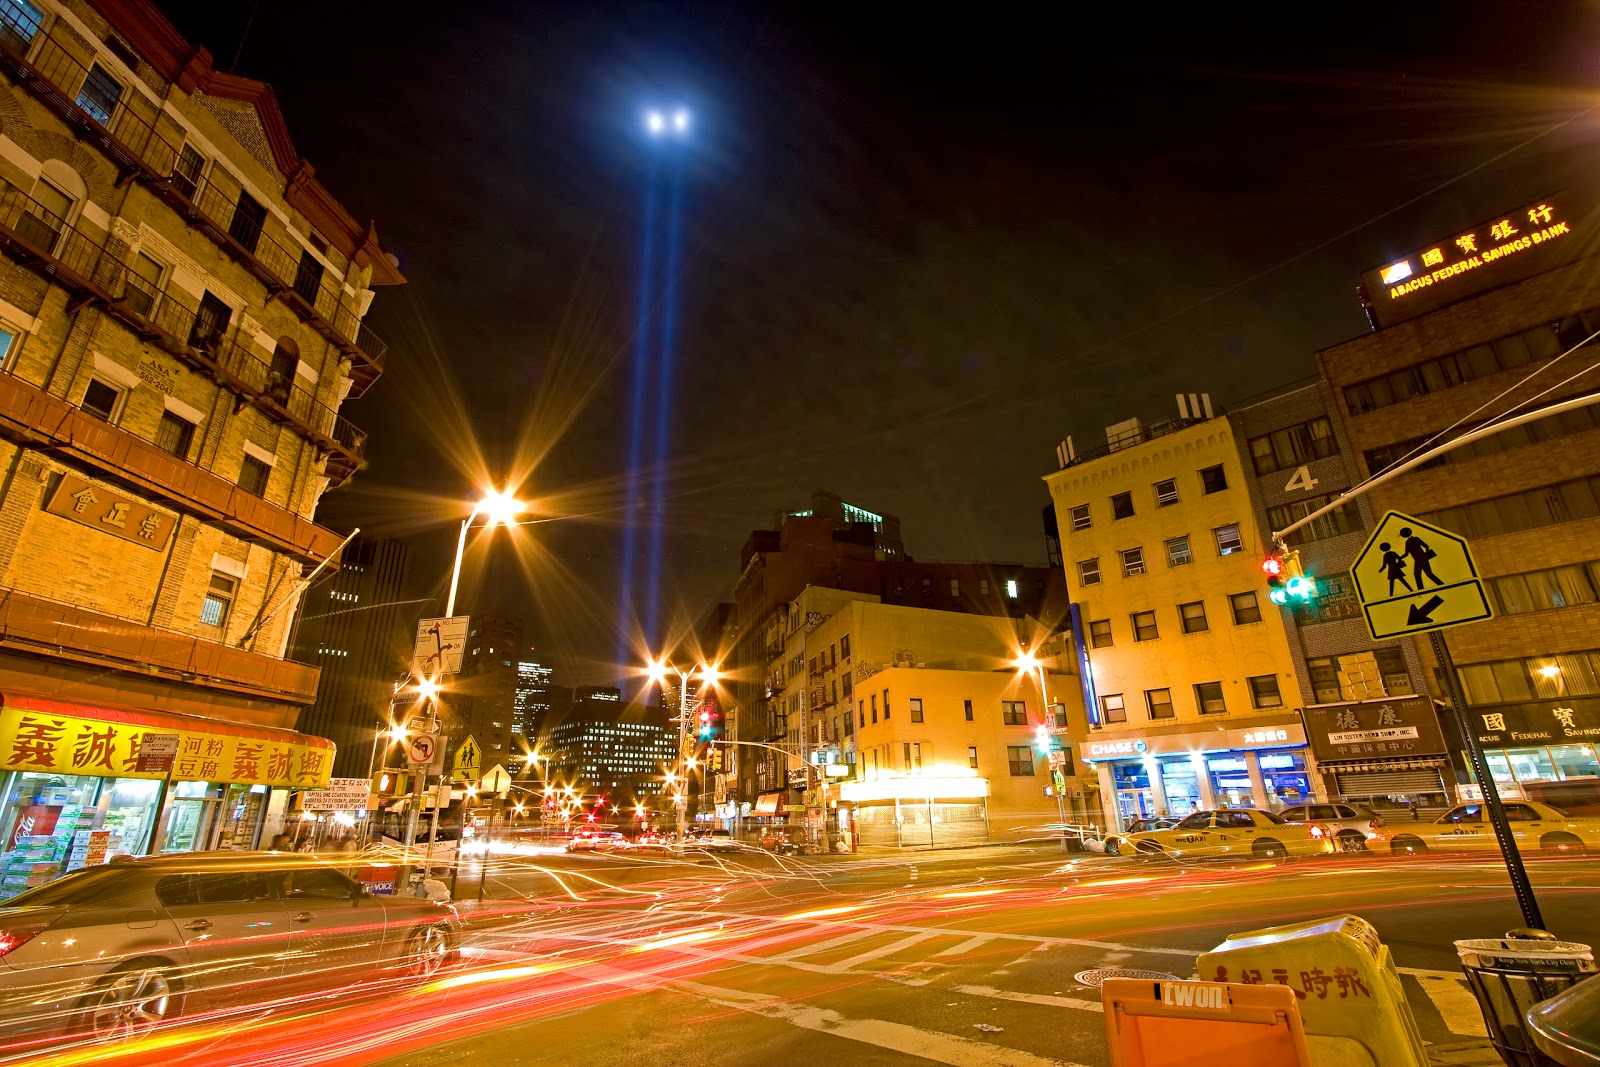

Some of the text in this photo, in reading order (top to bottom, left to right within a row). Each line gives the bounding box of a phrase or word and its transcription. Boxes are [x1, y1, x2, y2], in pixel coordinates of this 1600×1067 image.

[1421, 204, 1554, 268] 國寶銀行
[1390, 221, 1571, 299] ABACUS FEDERAL SAVINGS BANK
[150, 360, 170, 378] ASA
[140, 371, 173, 396] 562-2047
[1284, 464, 1319, 491] 4
[143, 734, 153, 743] NO
[1364, 731, 1379, 739] HERB
[1511, 731, 1551, 740] FEDERAL
[183, 735, 225, 757] 河粉
[1091, 741, 1134, 755] CHASE
[175, 758, 218, 780] 豆腐
[230, 742, 325, 785] 義誠興
[374, 882, 393, 890] VOICE
[1546, 959, 1559, 967] City
